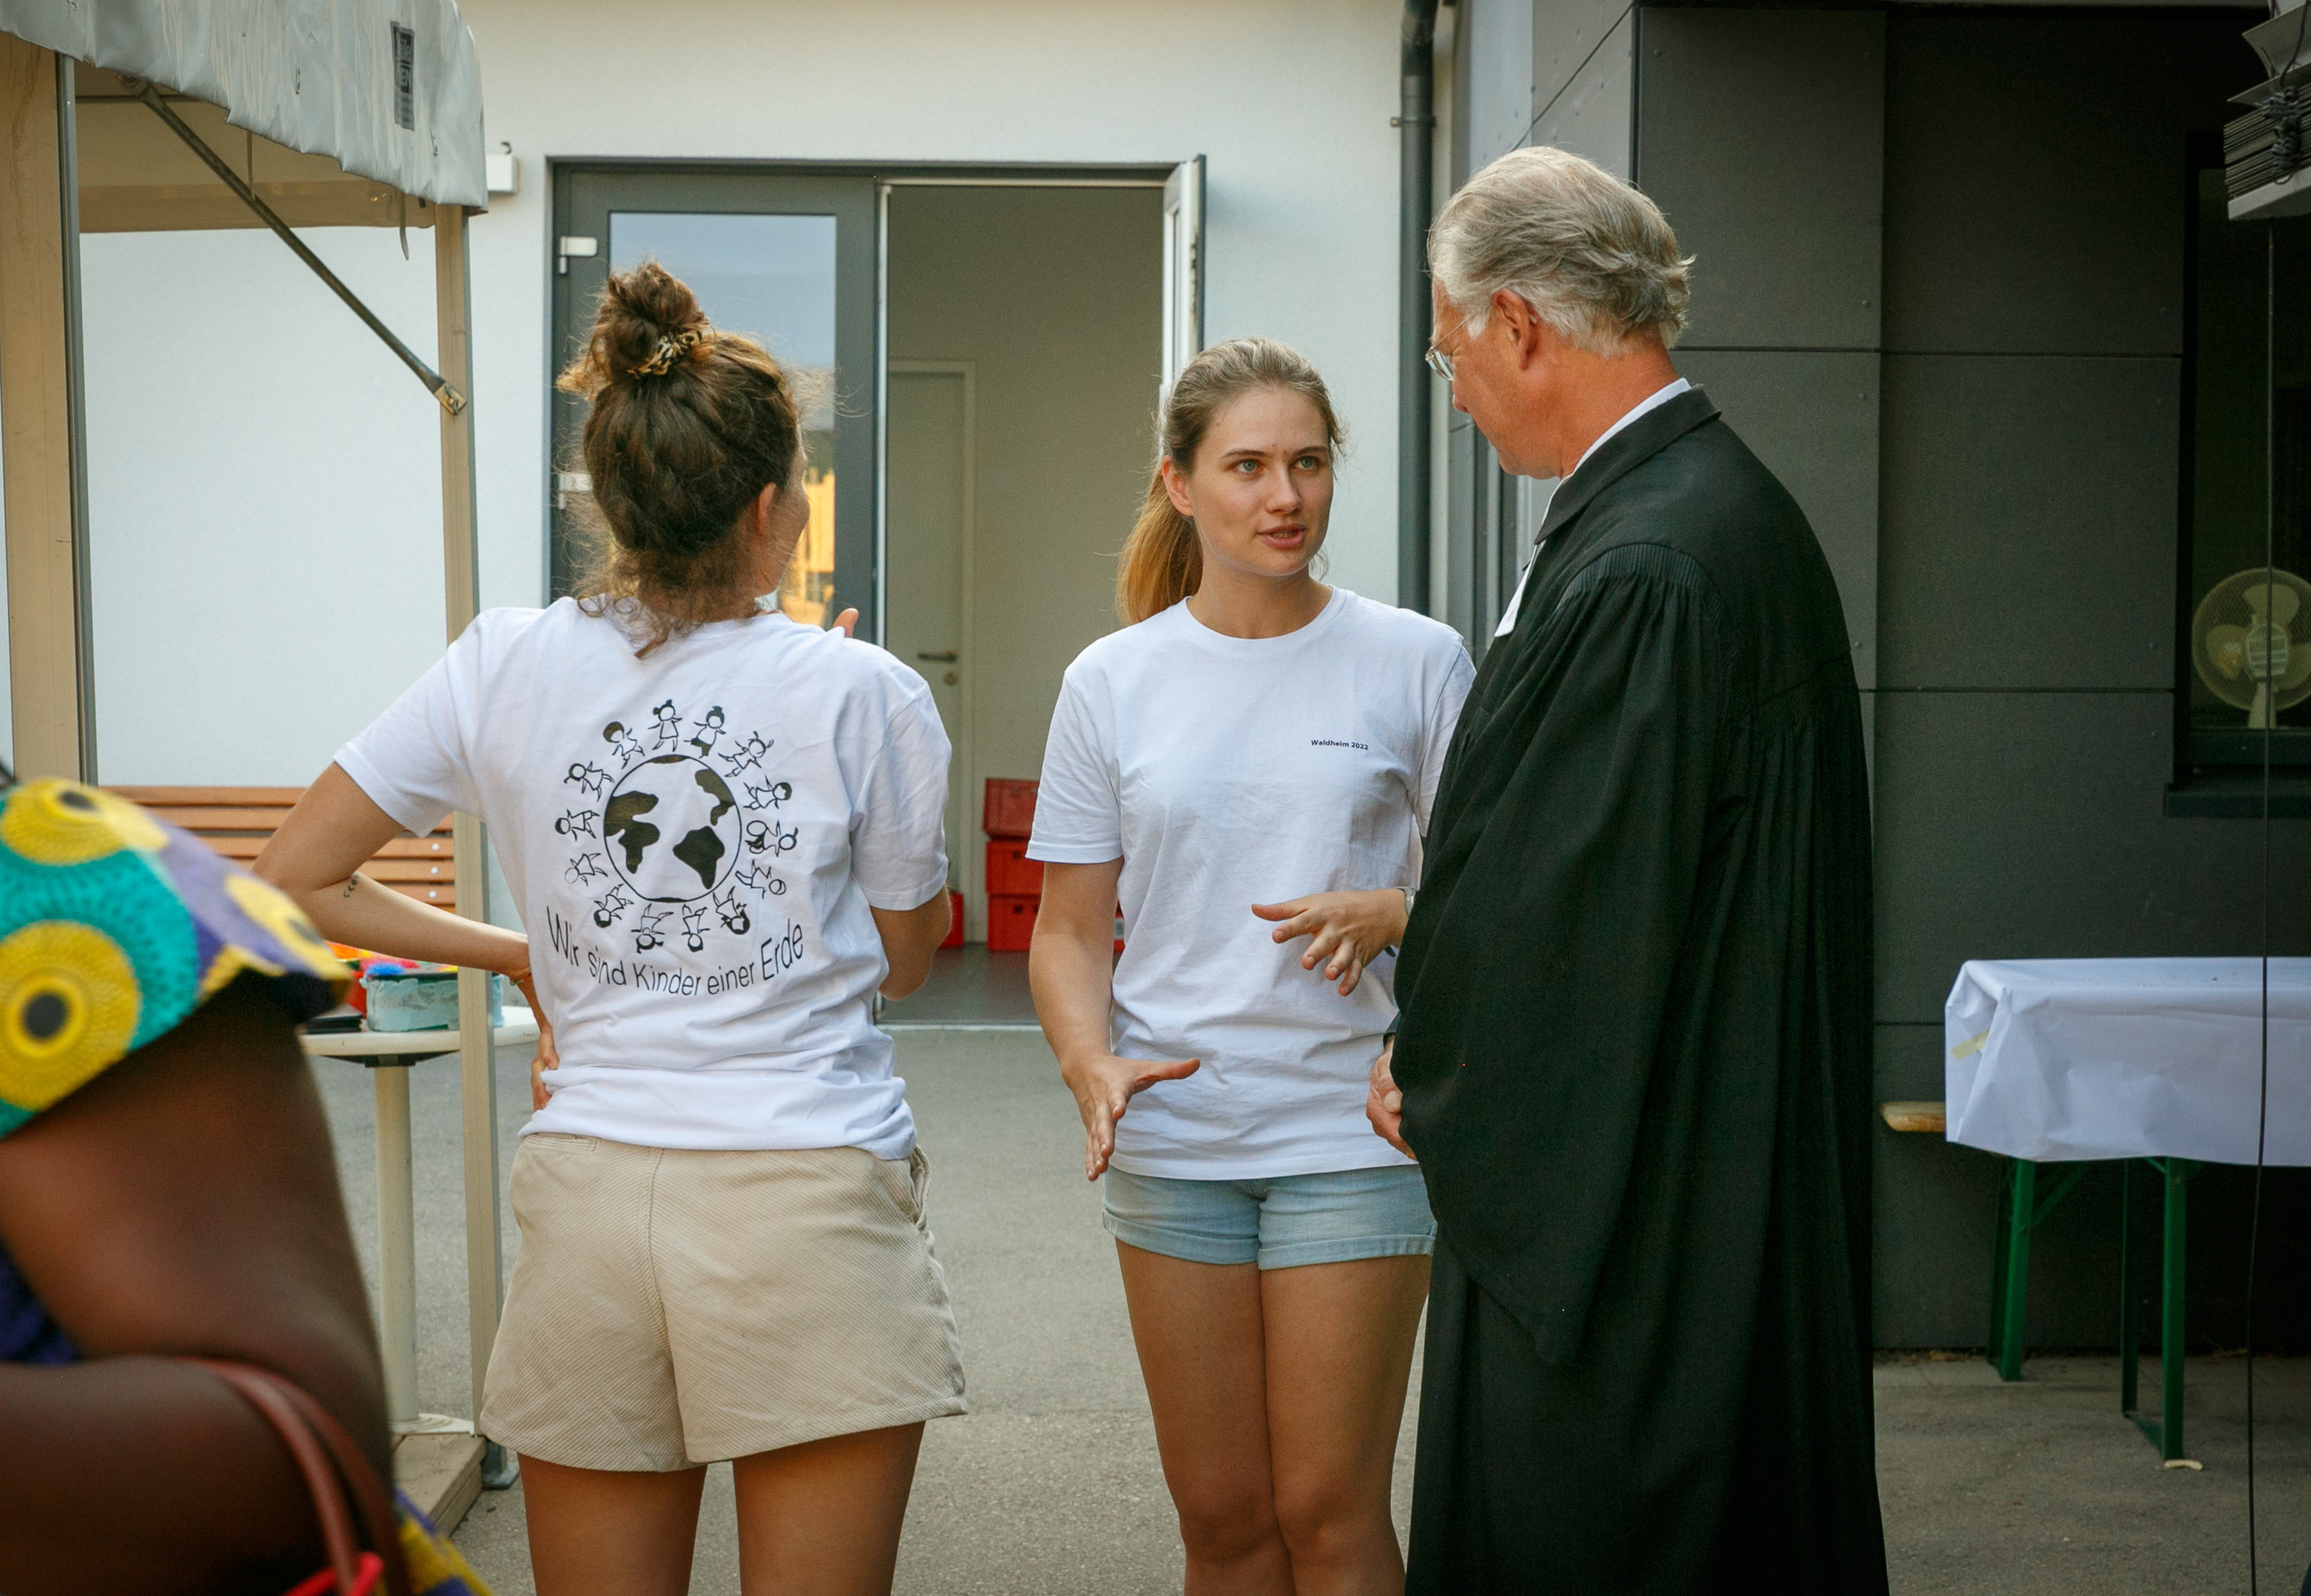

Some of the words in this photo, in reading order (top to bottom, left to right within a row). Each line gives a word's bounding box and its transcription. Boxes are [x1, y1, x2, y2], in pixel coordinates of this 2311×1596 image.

[1311, 739, 1350, 747] Waldheim
[1350, 741, 1369, 750] 2022
[546, 905, 579, 967] Wir
[588, 946, 626, 985] sind
[633, 962, 701, 996] Kinder
[707, 961, 755, 995] einer
[760, 917, 803, 981] Erde
